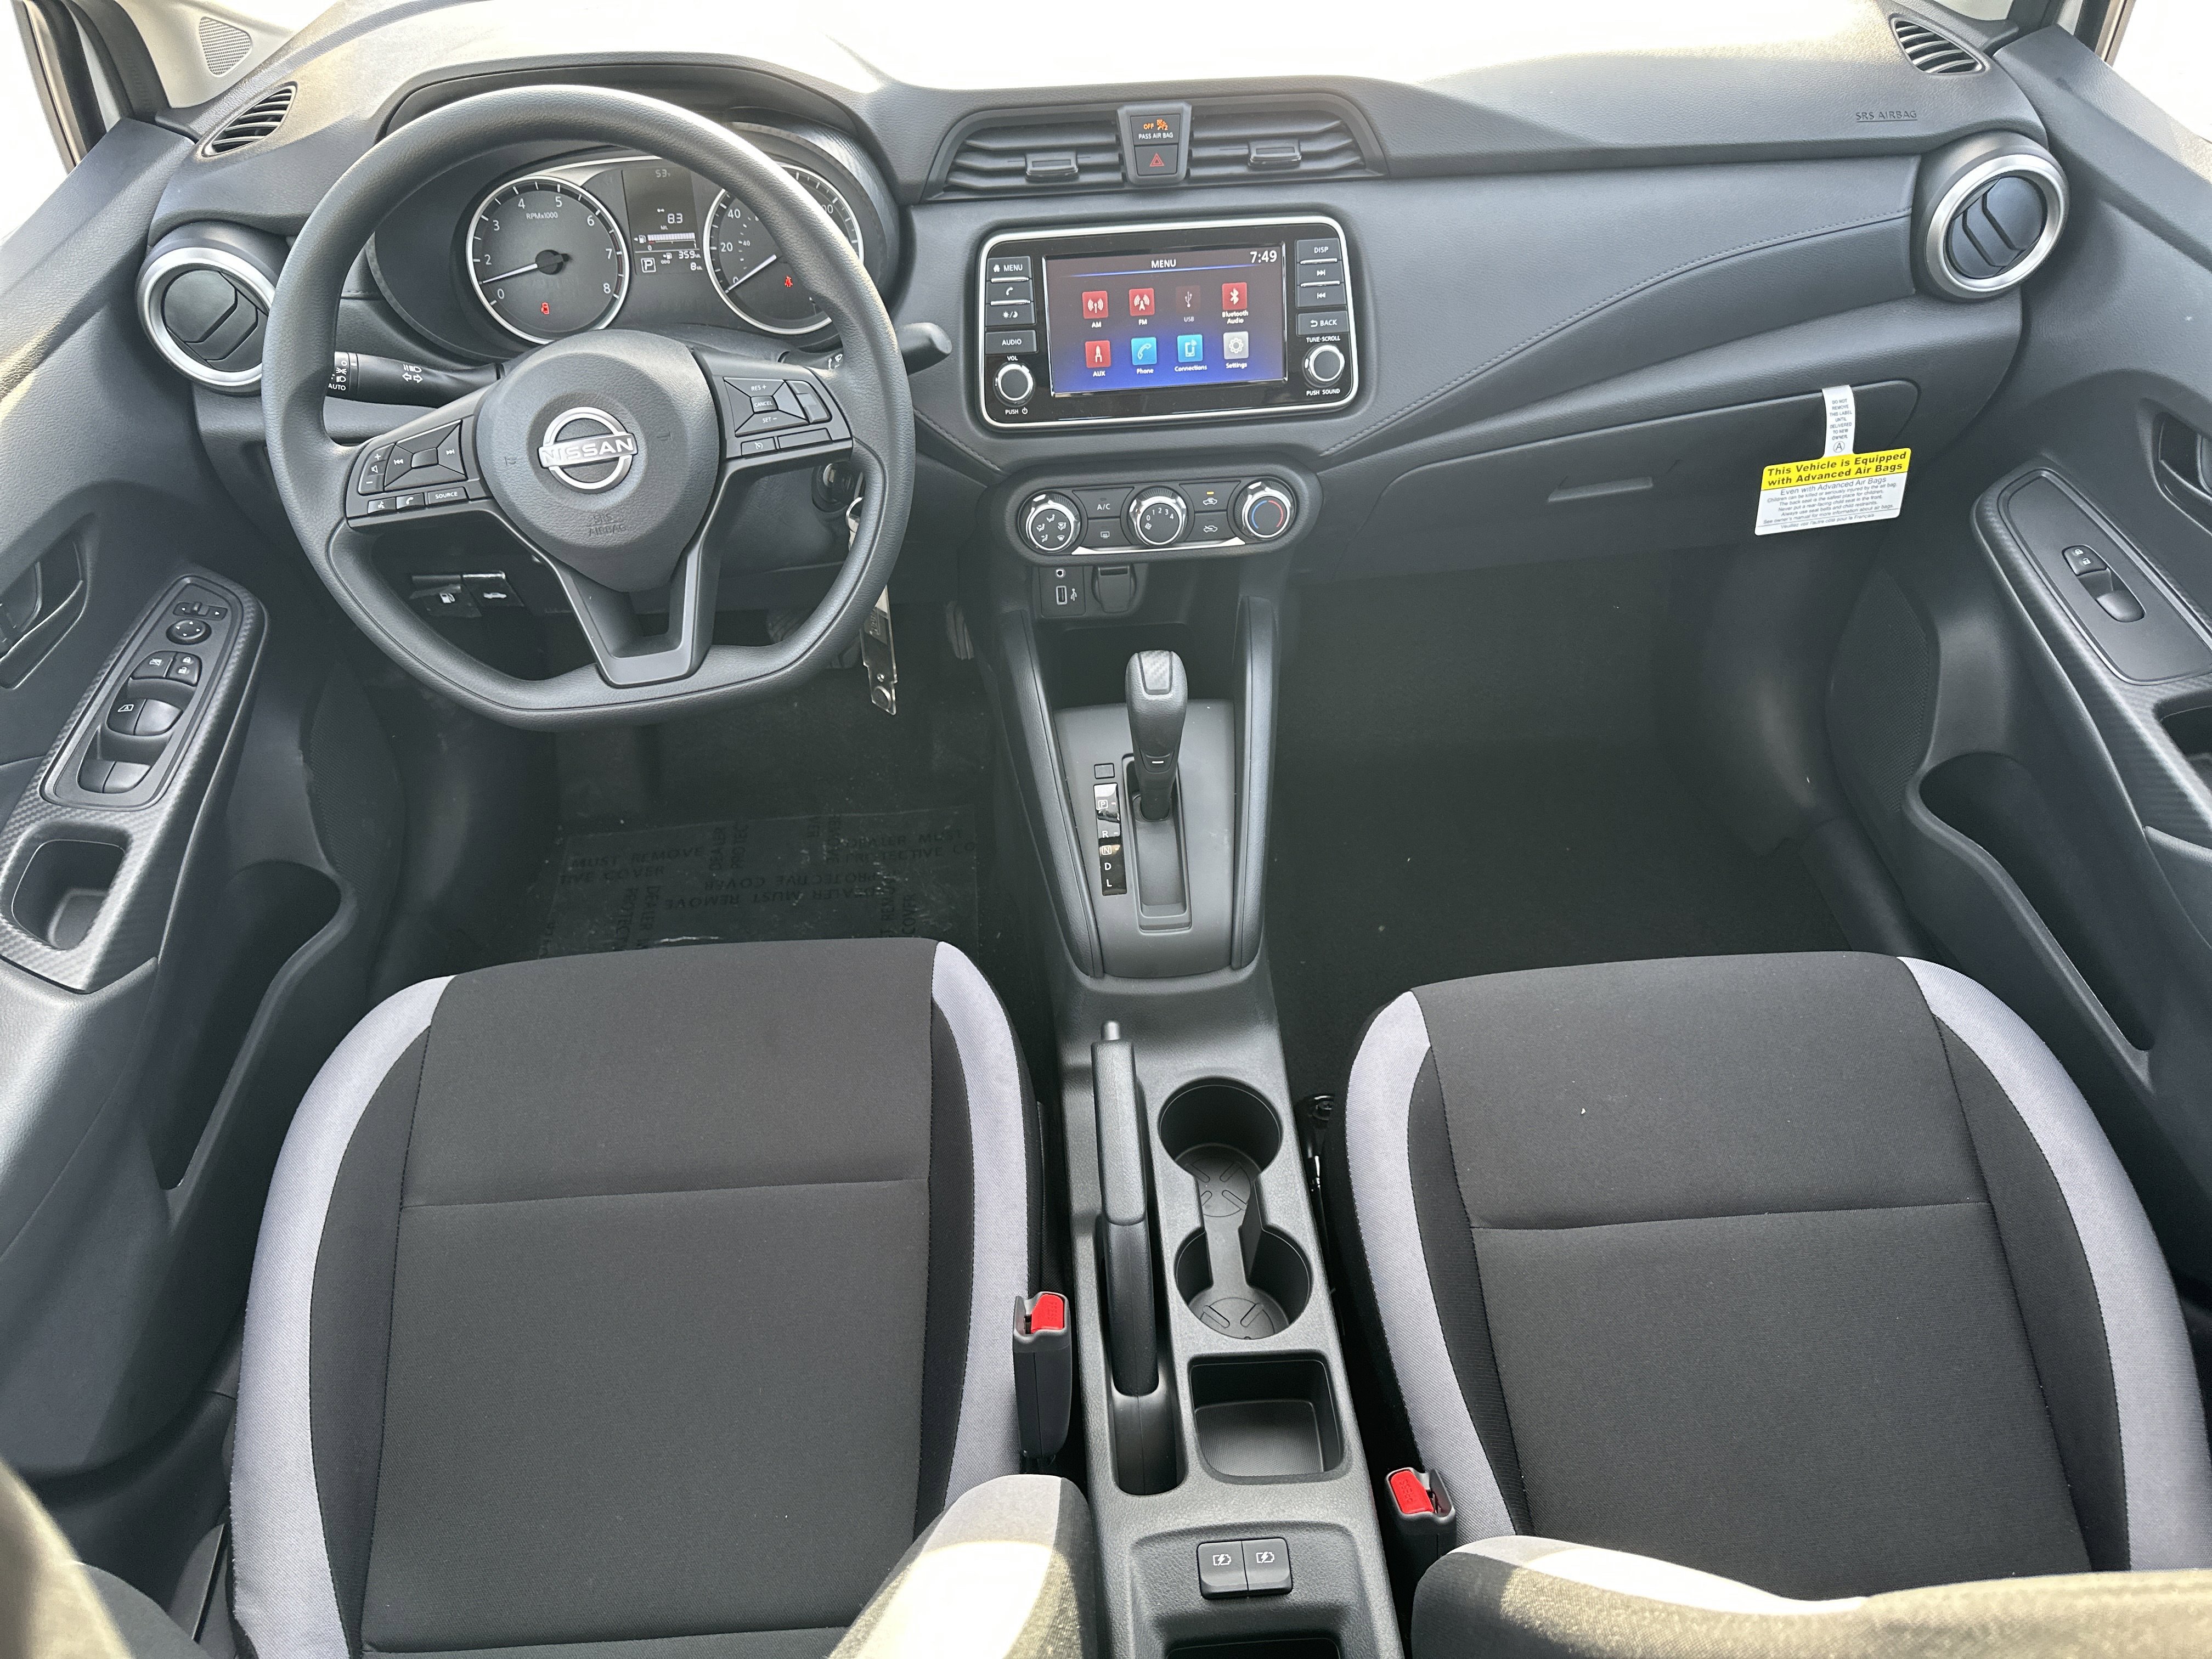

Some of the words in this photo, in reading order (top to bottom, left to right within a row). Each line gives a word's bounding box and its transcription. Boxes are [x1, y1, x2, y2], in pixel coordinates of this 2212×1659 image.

[1856, 112, 1875, 120] SRS
[1878, 110, 1917, 120] AIRBAG
[517, 198, 526, 208] 4
[555, 196, 563, 207] 5
[727, 208, 741, 219] 40
[493, 220, 500, 232] 3
[586, 215, 595, 227] 6
[720, 242, 733, 252] 20
[605, 248, 613, 259] 7
[679, 251, 695, 259] 359
[1250, 250, 1277, 263] 7:49
[484, 254, 492, 265] 2
[644, 259, 653, 270] P
[1151, 259, 1176, 268] MENU
[690, 262, 697, 271] 8
[1003, 264, 1023, 272] MENU
[497, 288, 505, 300] 0
[603, 283, 611, 294] 8
[541, 437, 636, 466] NISSAN
[1768, 466, 1791, 476] This
[1796, 460, 1836, 472] Vehicle
[1841, 459, 1850, 467] is
[1854, 451, 1907, 465] Equipped
[1768, 476, 1792, 487] with
[1796, 468, 1851, 482] Advanced
[1855, 466, 1871, 475] Air
[1875, 462, 1903, 474] Bags
[1818, 480, 1854, 490] Advanced
[435, 491, 458, 499] SOURCE
[1106, 879, 1113, 887] L
